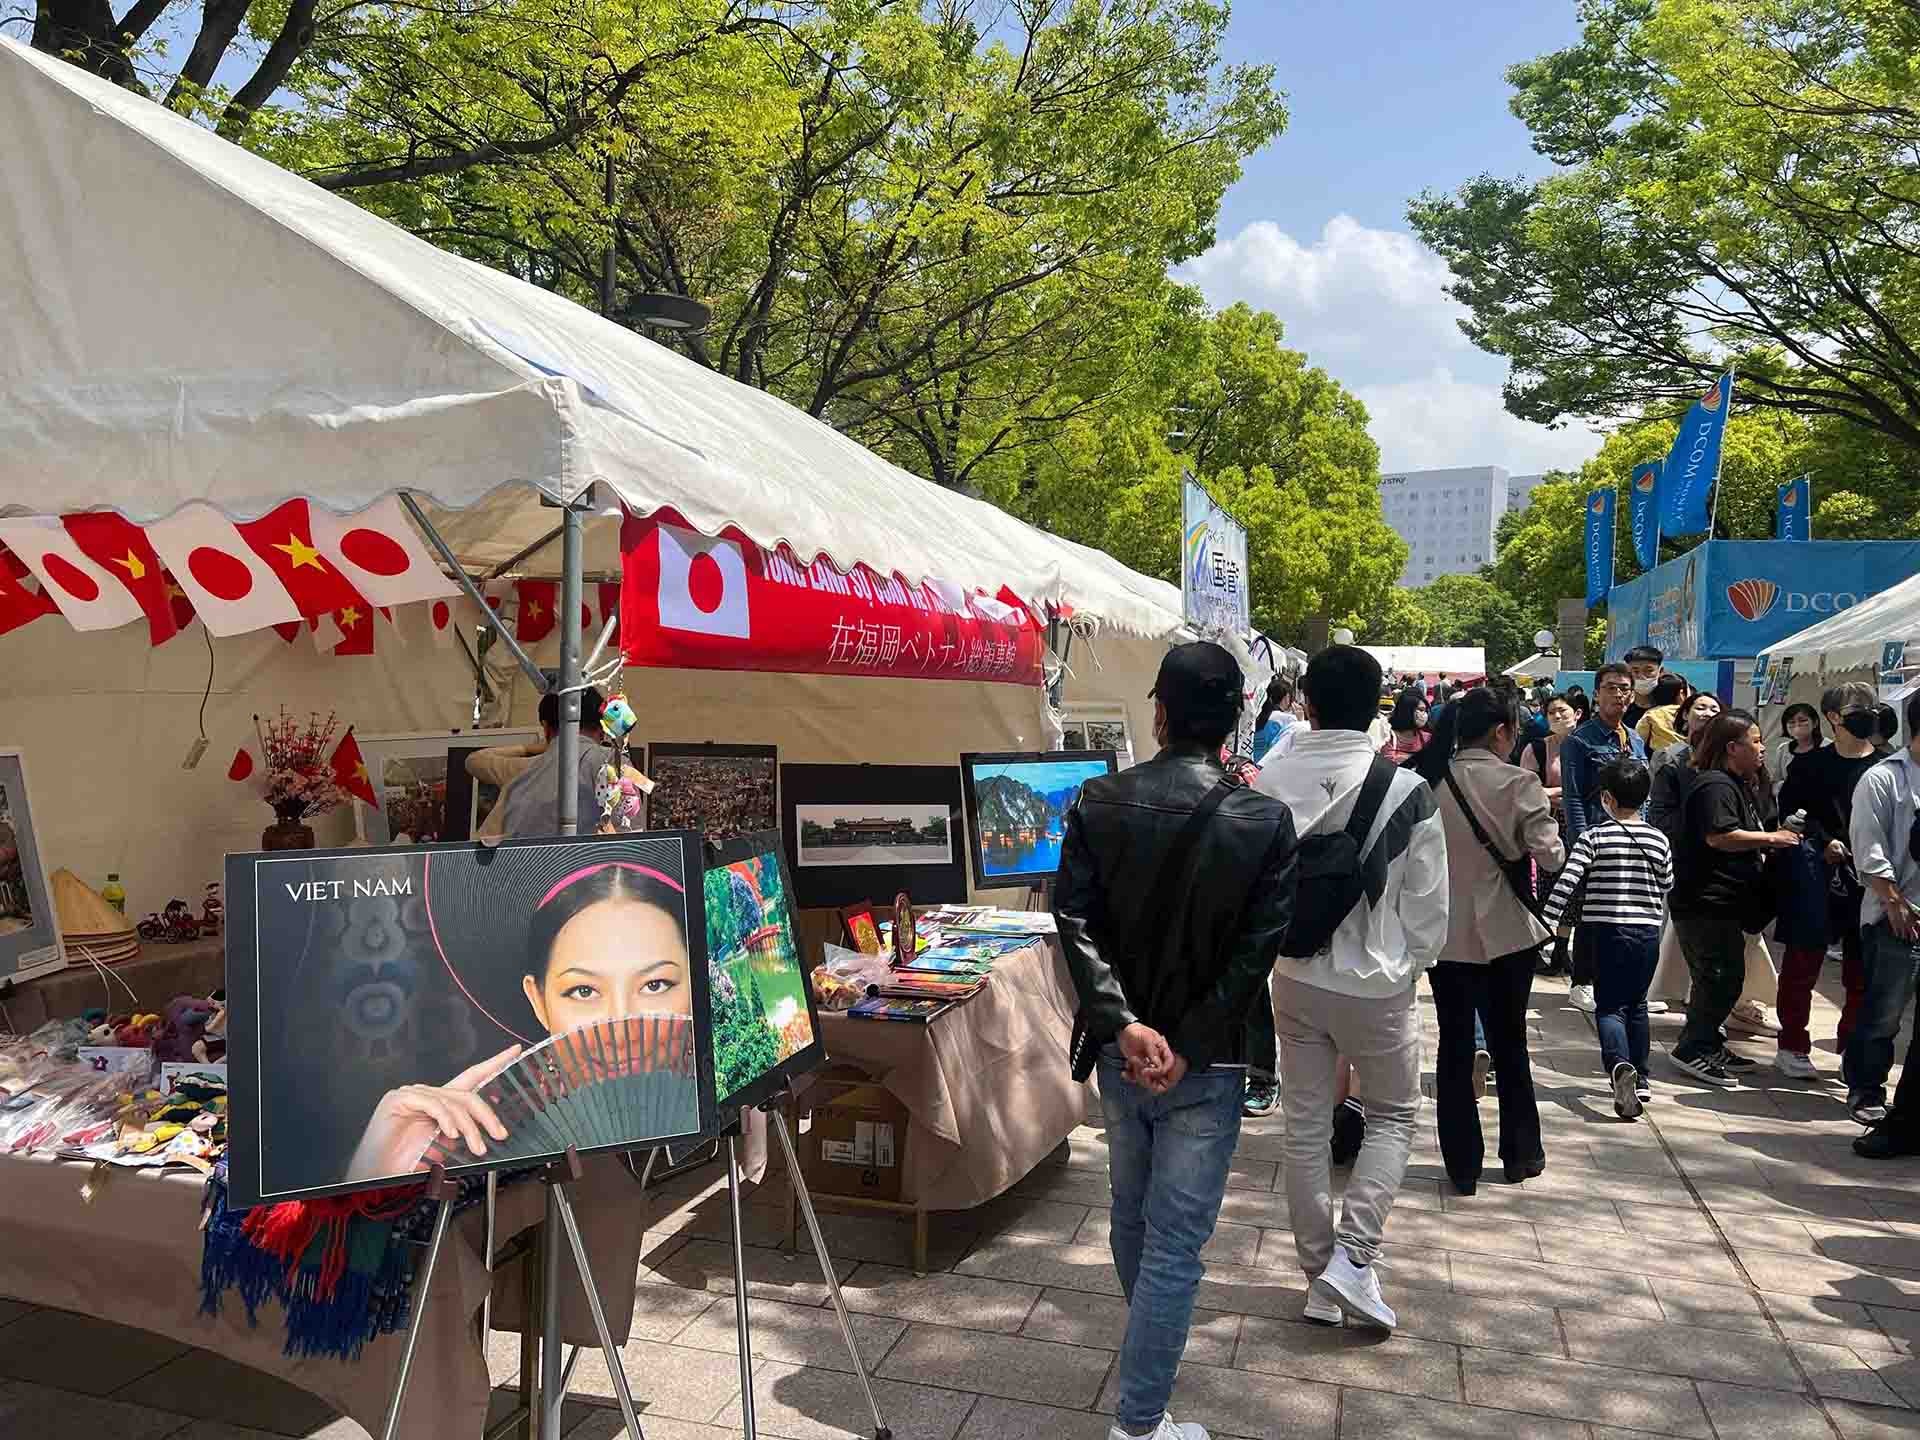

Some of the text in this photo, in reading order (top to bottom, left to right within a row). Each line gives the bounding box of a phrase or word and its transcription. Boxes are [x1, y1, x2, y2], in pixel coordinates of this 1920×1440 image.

[1682, 421, 1713, 479] DCOM
[1591, 520, 1601, 565] DCOM
[1785, 592, 1876, 613] DCO
[826, 615, 1017, 674] 在福岡ベトナム総領事館
[284, 876, 413, 902] VIET NAM
